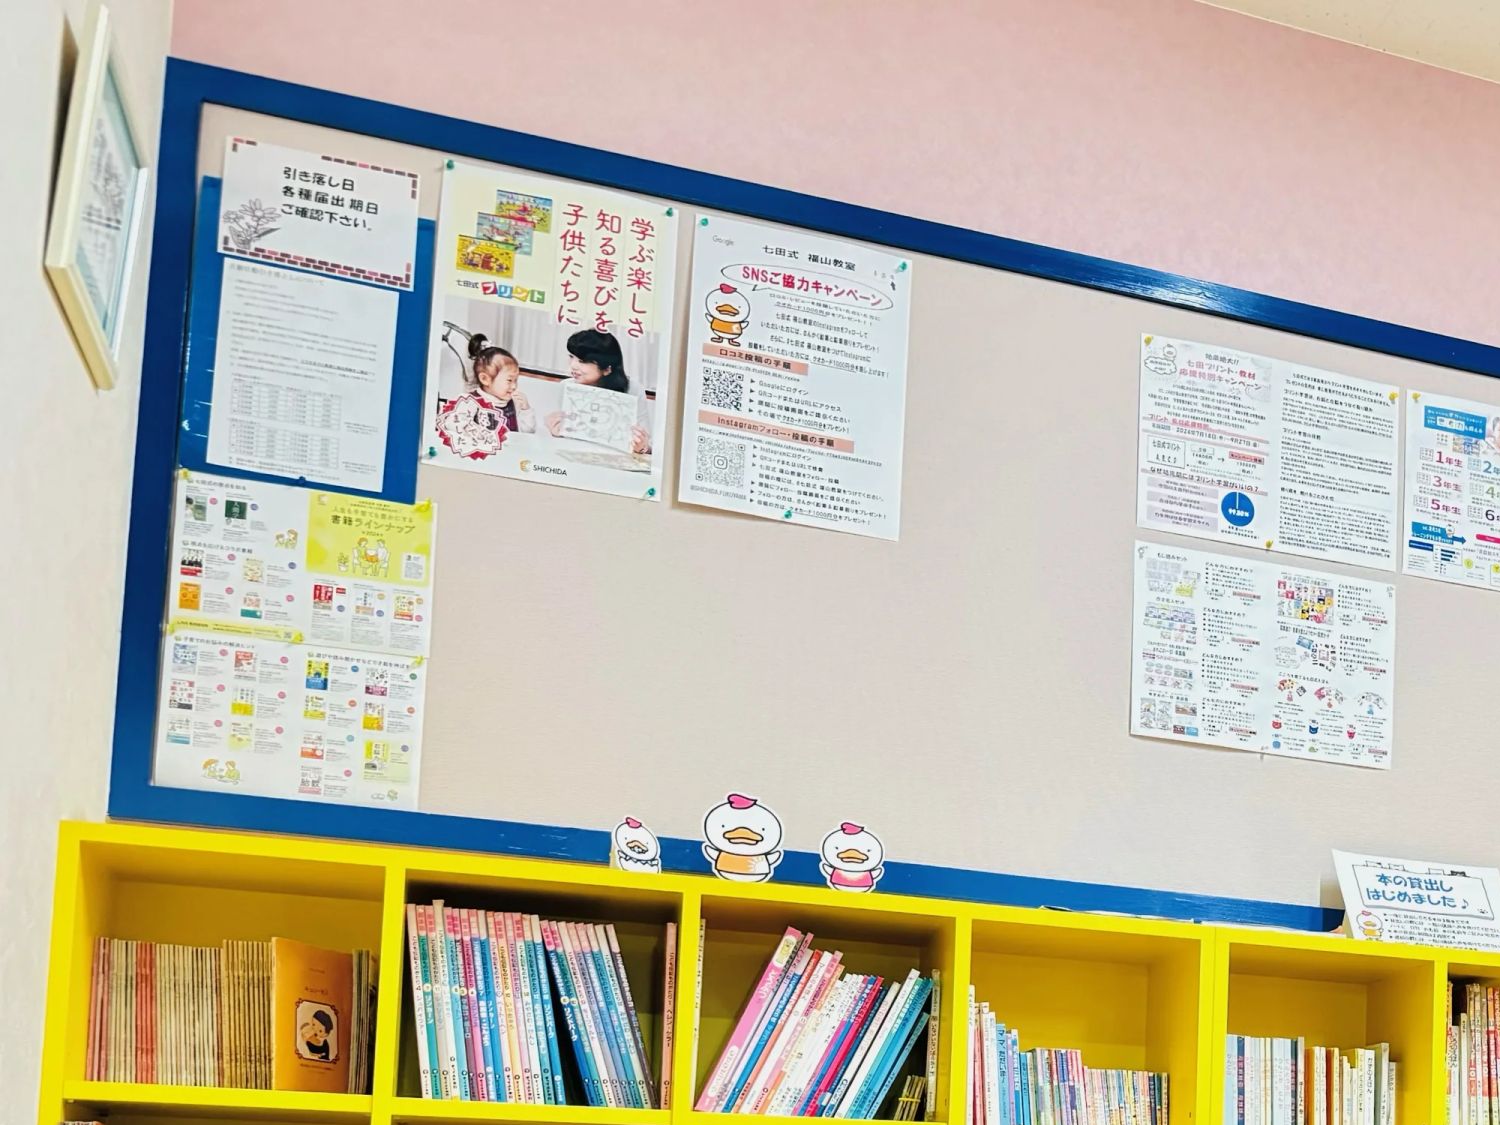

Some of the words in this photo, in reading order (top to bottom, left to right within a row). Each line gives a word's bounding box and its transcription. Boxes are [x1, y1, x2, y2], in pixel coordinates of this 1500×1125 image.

[283, 166, 354, 191] 引き落し日
[282, 185, 378, 214] 各種届出期日
[281, 203, 372, 231] ご確認下さい。
[557, 203, 587, 326] 子供たちに
[762, 244, 799, 260] 七田式
[807, 253, 856, 272] 福山教室
[593, 208, 622, 334] 知る喜びを
[627, 216, 655, 338] 学ぶ楽しさ
[481, 281, 545, 304] プリント
[741, 265, 882, 306] SNSご協力キャンペーン
[719, 347, 792, 370] 口コミ投稿の手順
[758, 378, 809, 396] Googleにログイン
[717, 416, 835, 447] Instagramフォロー・投稿の手順
[533, 464, 568, 476] SHICHIDA
[1435, 451, 1463, 468] 1年生
[1432, 475, 1462, 492] 3年生
[1431, 499, 1461, 515] 5年生
[331, 513, 416, 534] 書籍ラインナップ
[1376, 873, 1454, 892] 本の貸出し
[1366, 887, 1457, 909] はじめました
